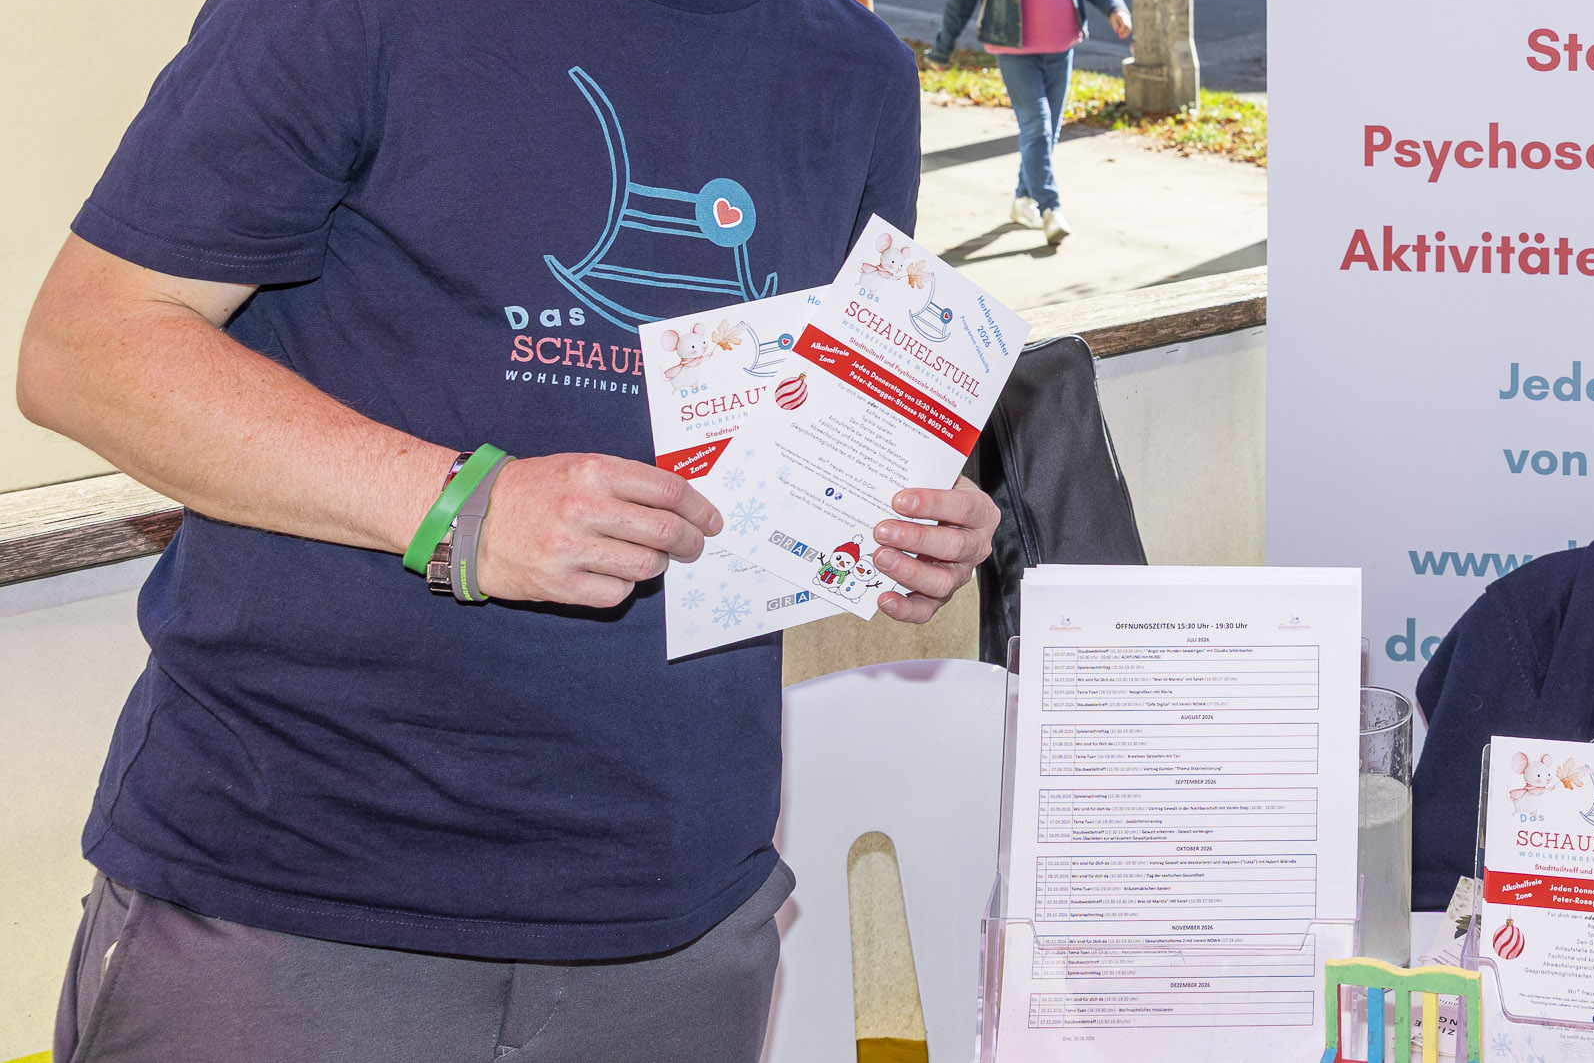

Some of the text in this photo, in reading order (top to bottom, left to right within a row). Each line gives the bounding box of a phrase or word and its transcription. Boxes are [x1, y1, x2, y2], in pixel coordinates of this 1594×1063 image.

[858, 286, 880, 303] Das
[504, 305, 585, 330] Das
[978, 295, 1008, 356] Herbst/Winter
[960, 315, 977, 346] Programm
[977, 325, 992, 348] 2026
[811, 340, 849, 357] Alkoholfreie
[818, 353, 835, 365] Zone
[844, 298, 984, 399] SCHAUKELSTUHL
[841, 317, 903, 360] WOHLBEFINDEN
[914, 364, 943, 386] MENTAL
[946, 385, 973, 405] HEALTH
[848, 335, 958, 408] Stadtteiltreff und Psychosoziale Anlaufstelle
[505, 370, 639, 395] WOHLBEFINDEN
[680, 384, 707, 399] Das
[847, 370, 954, 438] Peter-Rosegger-Strasse 101, 8052 Graz
[851, 359, 962, 431] Jeden Donnerstag von 15:30 bis 19:30 Uhr
[686, 412, 748, 431] WOHLBEFIN
[674, 445, 716, 471] Alkoholfreie
[690, 461, 708, 475] Zone
[1503, 449, 1587, 476] von
[769, 531, 818, 561] GRAZ
[1116, 622, 1176, 630] ÖFFNUNGSZEITEN
[1520, 813, 1544, 822] Das
[1535, 863, 1578, 873] Stadtteiltreff
[1580, 867, 1592, 875] und
[1501, 879, 1542, 892] Alkoholfreie
[1515, 892, 1532, 900] Zone
[1549, 884, 1571, 892] Jeden
